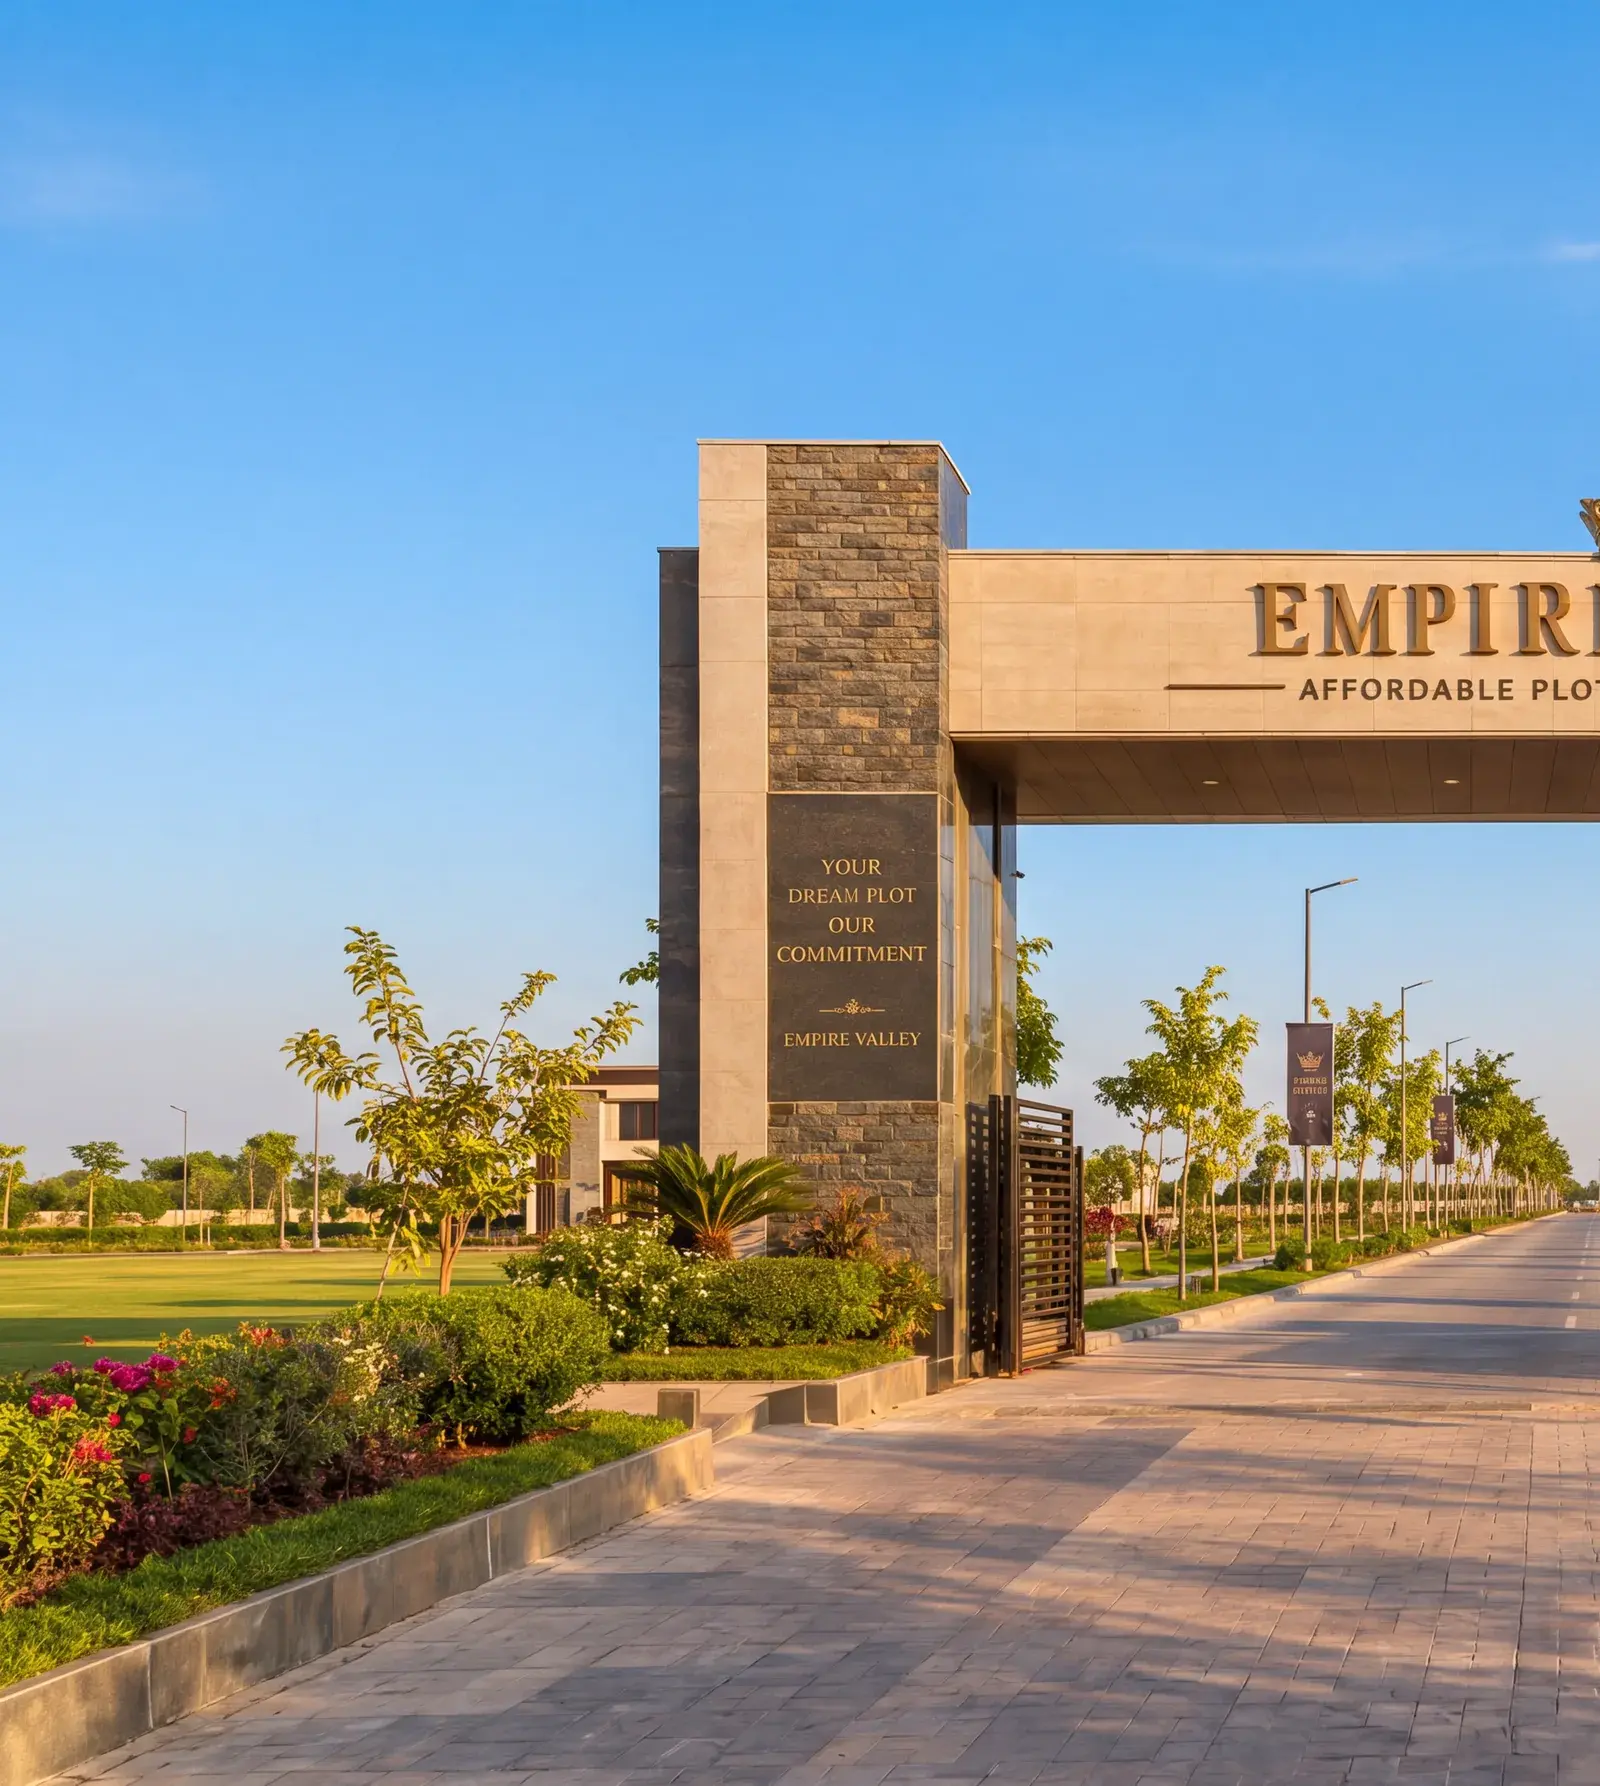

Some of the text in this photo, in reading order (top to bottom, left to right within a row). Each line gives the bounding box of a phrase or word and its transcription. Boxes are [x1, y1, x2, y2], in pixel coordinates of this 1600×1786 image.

[1298, 678, 1515, 702] AFFORDABLE
[821, 859, 882, 875] YOUR
[788, 888, 917, 904] DREAM PLOT
[828, 917, 875, 933] OUR
[777, 946, 928, 963] COMMITMENT
[784, 1032, 922, 1047] EMPIRE VALLEY
